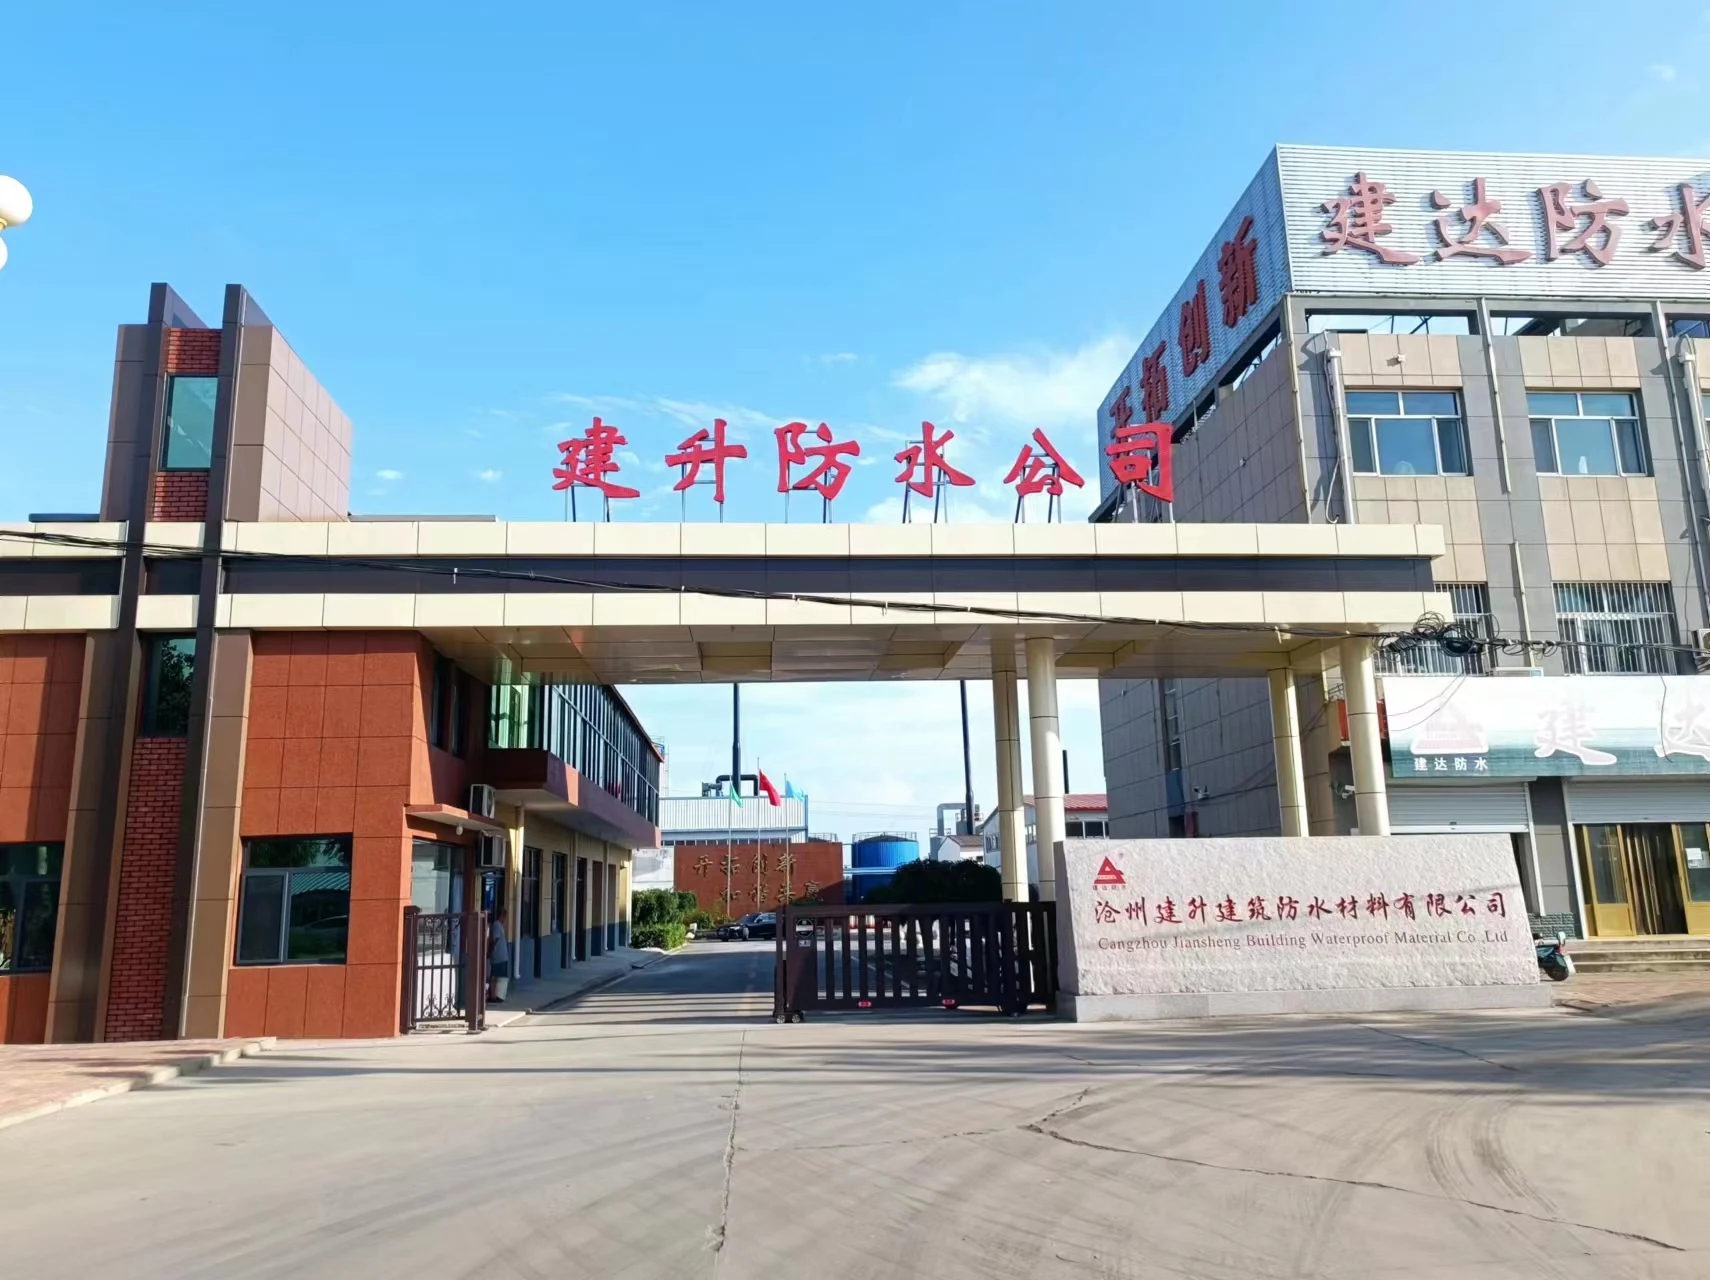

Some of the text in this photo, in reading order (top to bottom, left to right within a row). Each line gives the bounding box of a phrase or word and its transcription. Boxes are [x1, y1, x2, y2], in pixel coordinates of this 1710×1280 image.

[1321, 172, 1710, 270] 建达防水
[552, 416, 1174, 503] 建升防水公司
[1413, 756, 1489, 772] 建达防水
[1095, 892, 1506, 926] 沧州建升建筑防水材料有限公司
[1098, 937, 1168, 953] Cangzhou
[1172, 935, 1241, 950] Jiansheng
[1246, 934, 1307, 949] Building
[1311, 932, 1390, 947] Waterproof
[1394, 931, 1452, 944] Material
